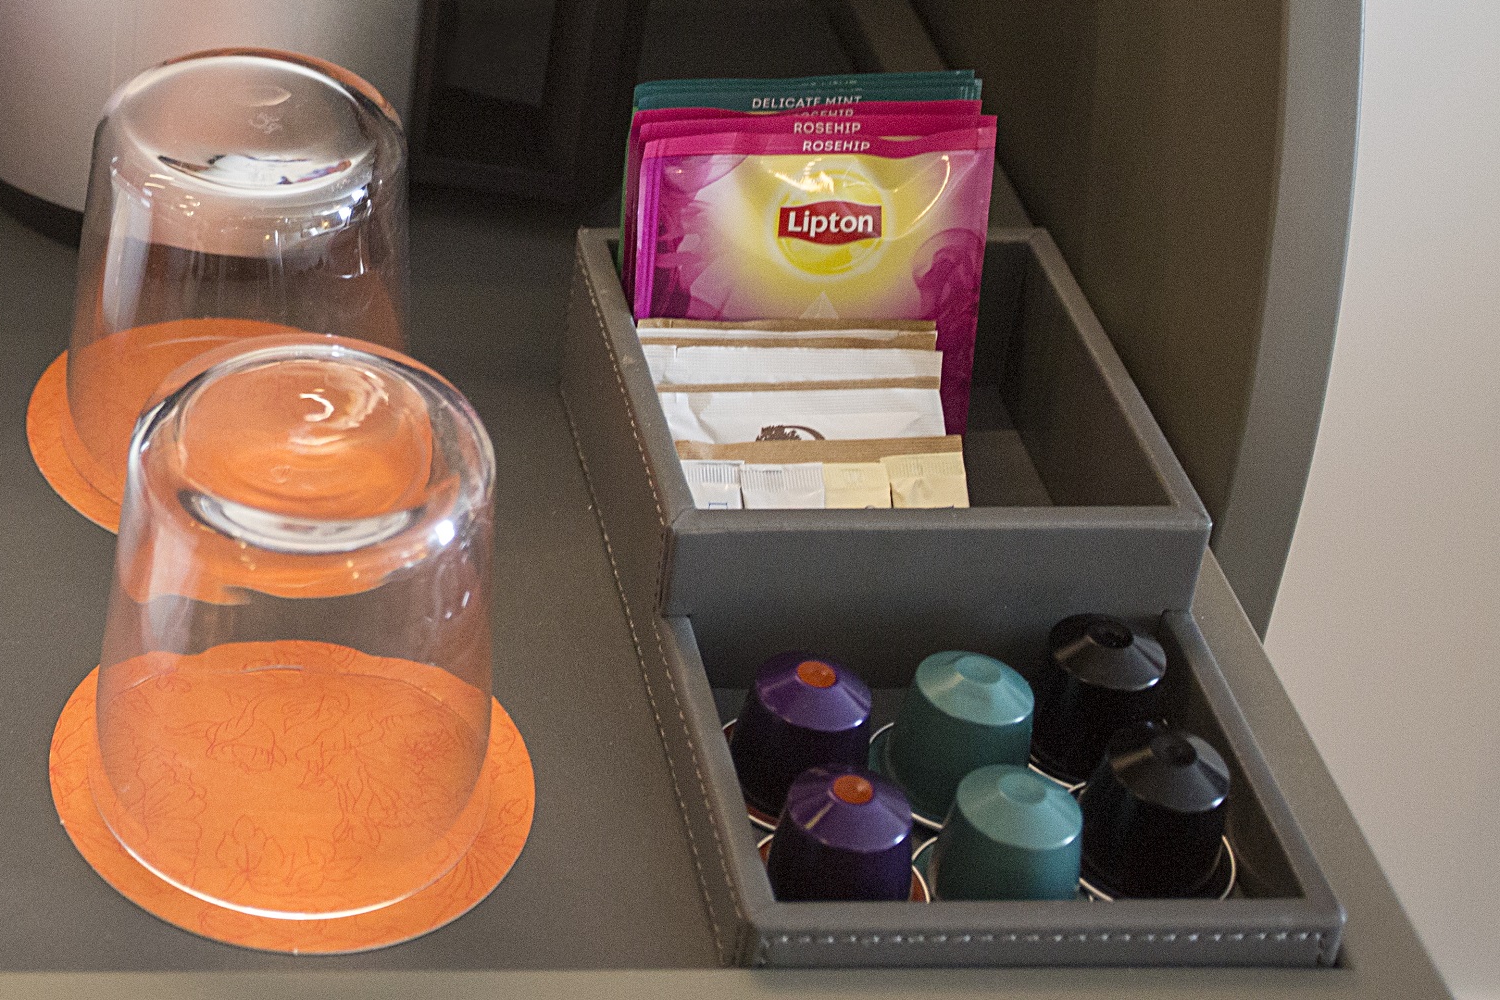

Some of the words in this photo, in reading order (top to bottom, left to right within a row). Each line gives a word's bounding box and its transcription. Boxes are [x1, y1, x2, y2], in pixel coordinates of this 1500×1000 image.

[752, 96, 821, 109] DELICATE
[825, 95, 862, 106] MINT
[794, 121, 861, 134] ROSEHIP
[802, 140, 871, 152] ROSEHIP
[787, 210, 874, 238] Lipton
